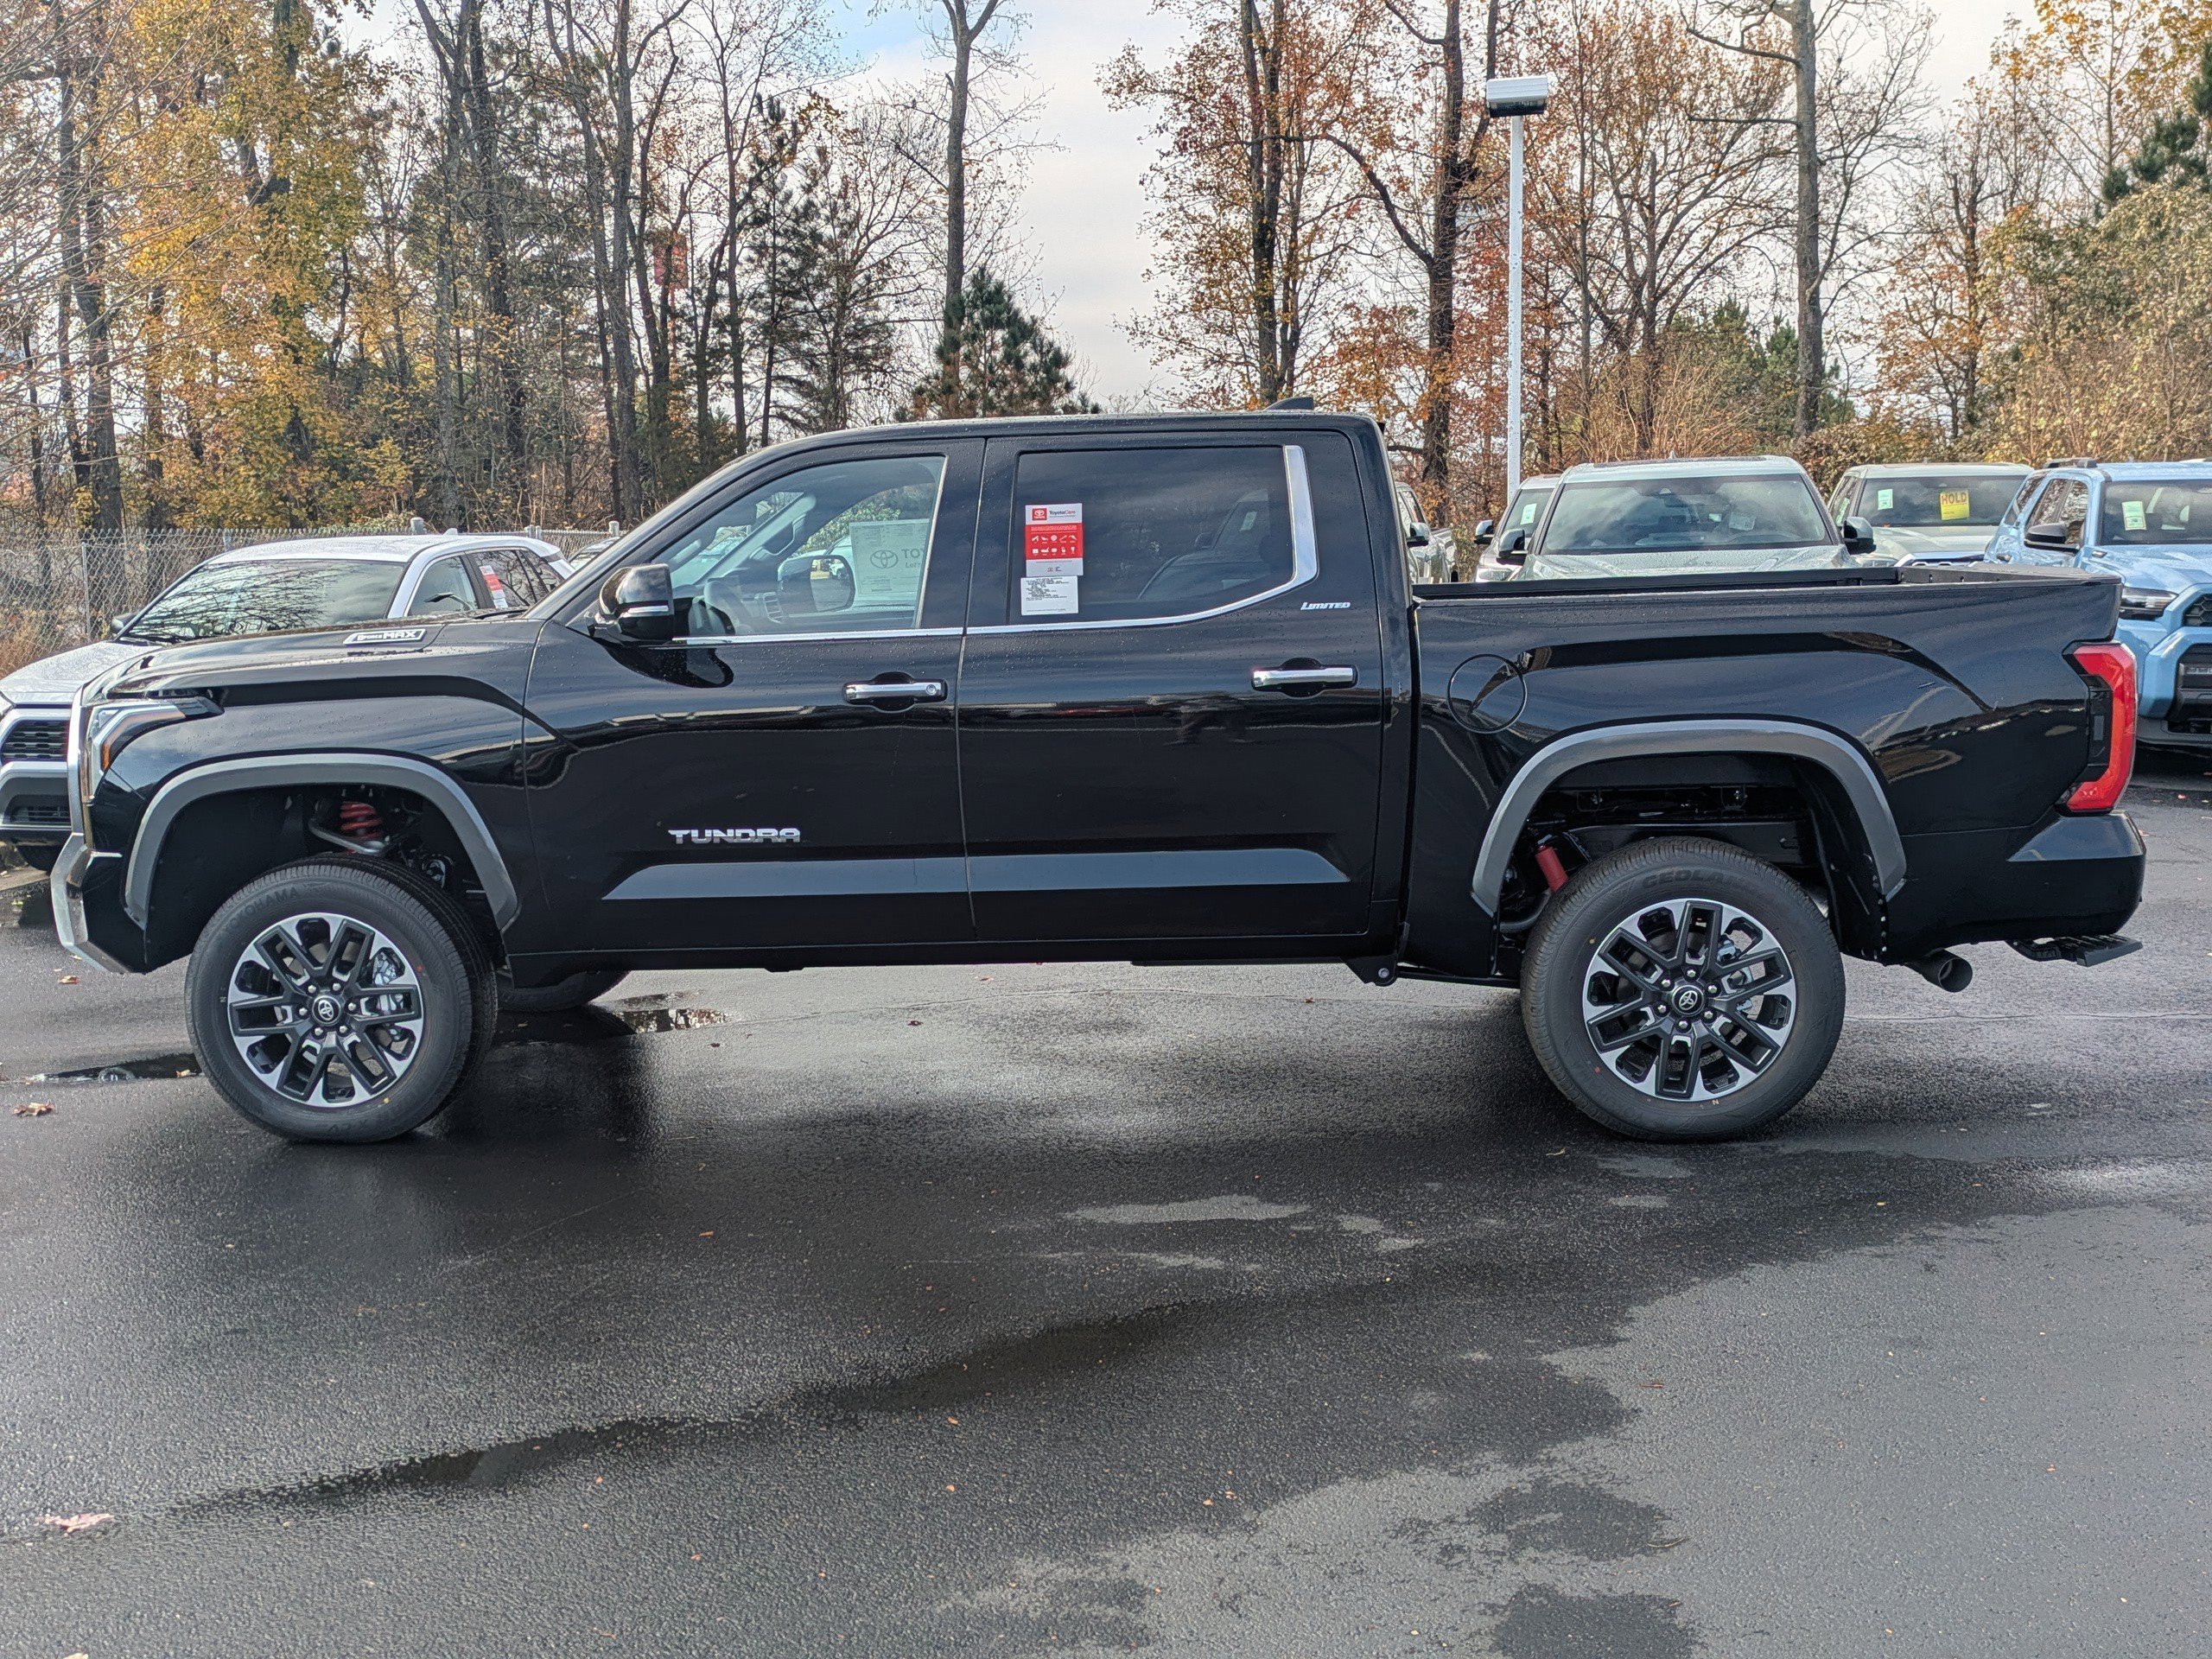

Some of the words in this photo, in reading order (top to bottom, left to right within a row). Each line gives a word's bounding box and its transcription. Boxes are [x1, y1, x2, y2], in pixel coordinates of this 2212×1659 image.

[1942, 492, 1967, 505] HOLD
[383, 631, 416, 639] MAX
[668, 828, 801, 844] TUNDRA
